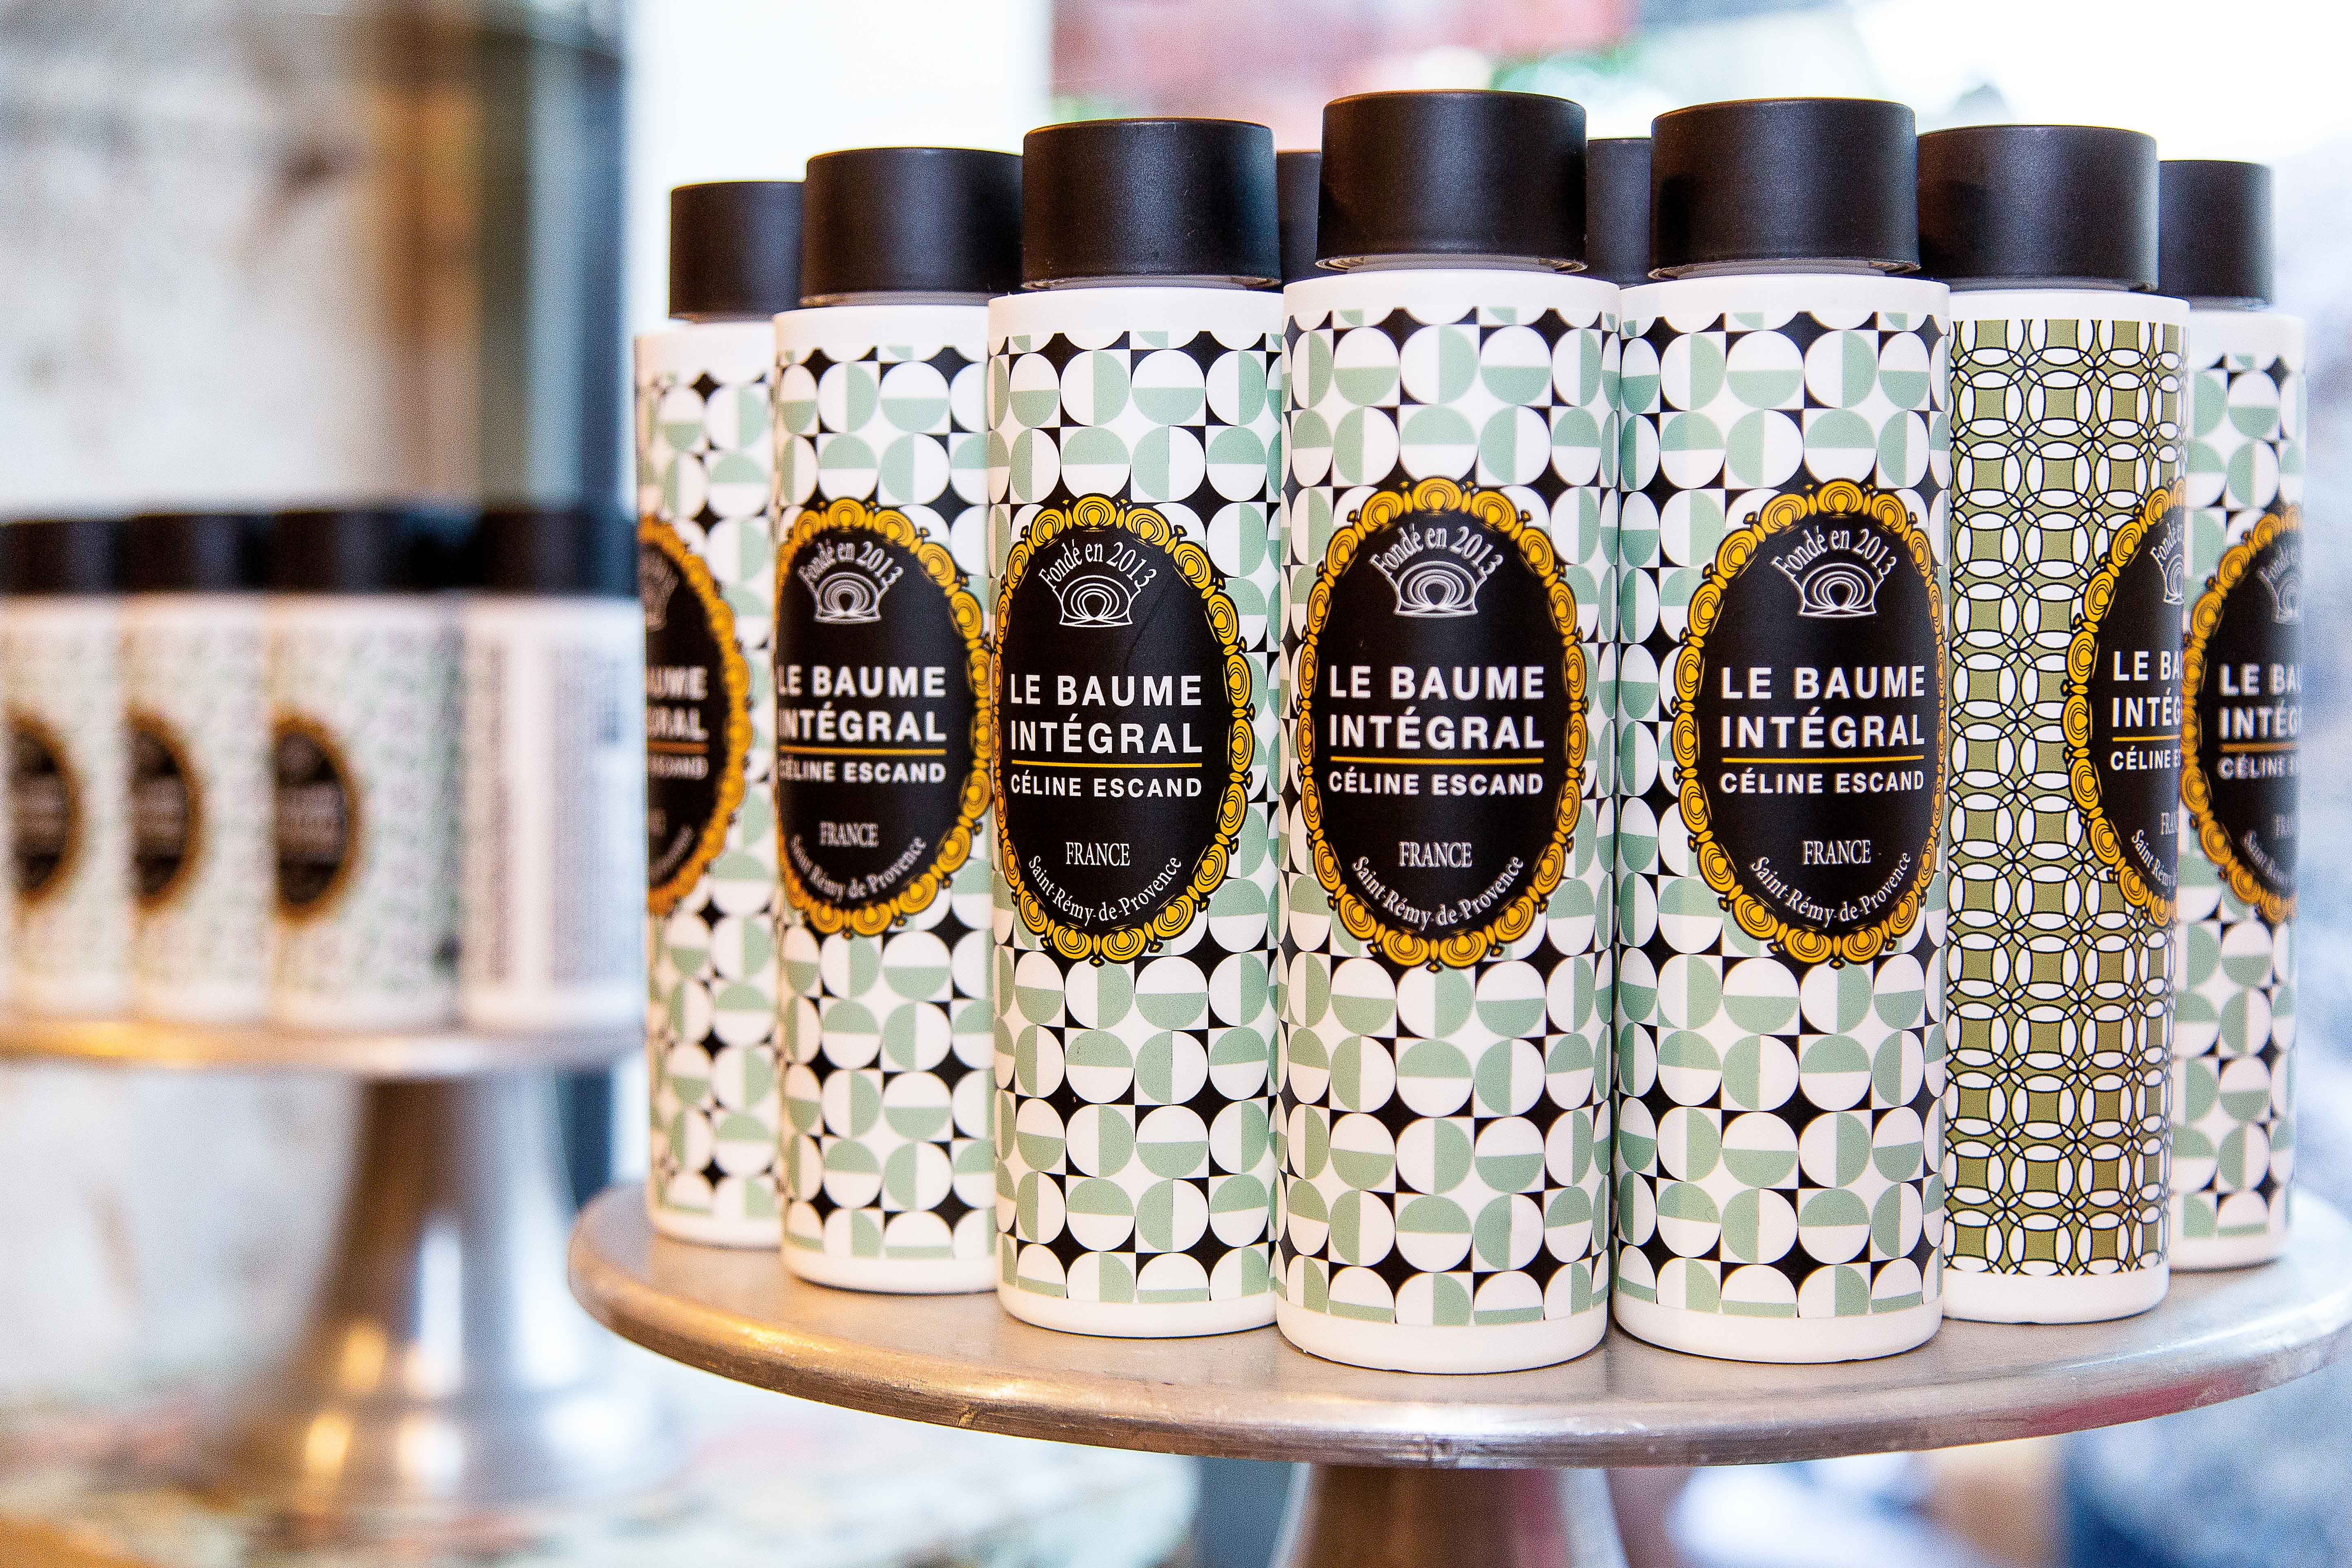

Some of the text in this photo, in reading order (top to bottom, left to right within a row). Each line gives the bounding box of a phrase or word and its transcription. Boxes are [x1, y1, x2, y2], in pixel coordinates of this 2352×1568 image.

[836, 542, 855, 562] en
[856, 541, 904, 586] 2013
[1038, 539, 1157, 590] Fondé en 2013
[1369, 523, 1503, 577] Fondé en 2013
[1770, 526, 1898, 578] Fondé en 2013
[777, 664, 946, 697] LE BAUME
[1723, 665, 1925, 699] LE BAUME
[2113, 651, 2149, 681] LE
[2219, 663, 2261, 696] LE
[1011, 674, 1201, 707] LE BAUME
[1330, 665, 1544, 701] LE BAUME
[1011, 713, 1202, 754] INTÉGRAL
[1330, 706, 1544, 750] INTÉGRAL
[1722, 706, 1925, 748] INTÉGRAL
[843, 762, 946, 783] ESCAND
[2110, 745, 2171, 771] CÉLINE
[1011, 770, 1202, 798] CÉLINE ESCAND
[1329, 766, 1543, 796] CÉLINE ESCAND
[1721, 767, 1924, 794] CÉLINE ESCAND
[819, 821, 879, 847] FRANCE
[1066, 842, 1130, 866] FRANCE
[1400, 842, 1472, 868] FRANCE
[1804, 840, 1871, 865] FRANCE
